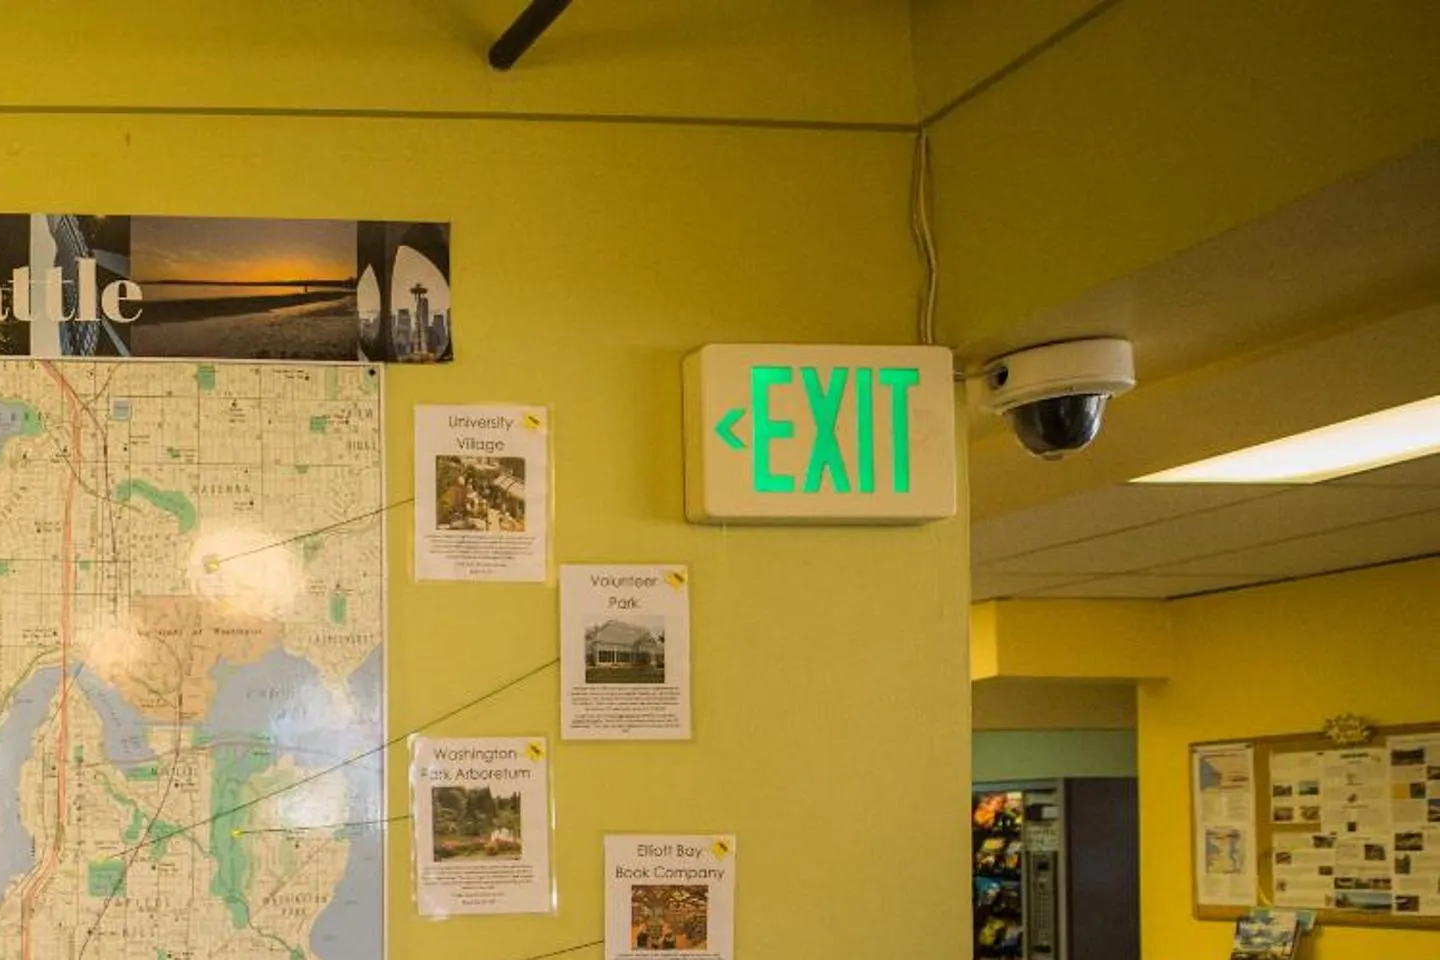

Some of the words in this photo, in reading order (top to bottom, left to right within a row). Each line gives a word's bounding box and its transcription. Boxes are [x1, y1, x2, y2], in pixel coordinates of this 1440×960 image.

[449, 416, 514, 431] University
[751, 366, 920, 493] EXIT
[457, 437, 505, 453] Village
[590, 575, 658, 588] Volunteer
[609, 597, 640, 609] Park
[434, 748, 517, 763] Washington
[456, 768, 530, 780] Arboretum
[637, 844, 673, 857] Elliott
[677, 845, 702, 857] Bay
[616, 867, 651, 878] Book
[654, 866, 724, 880] Company
